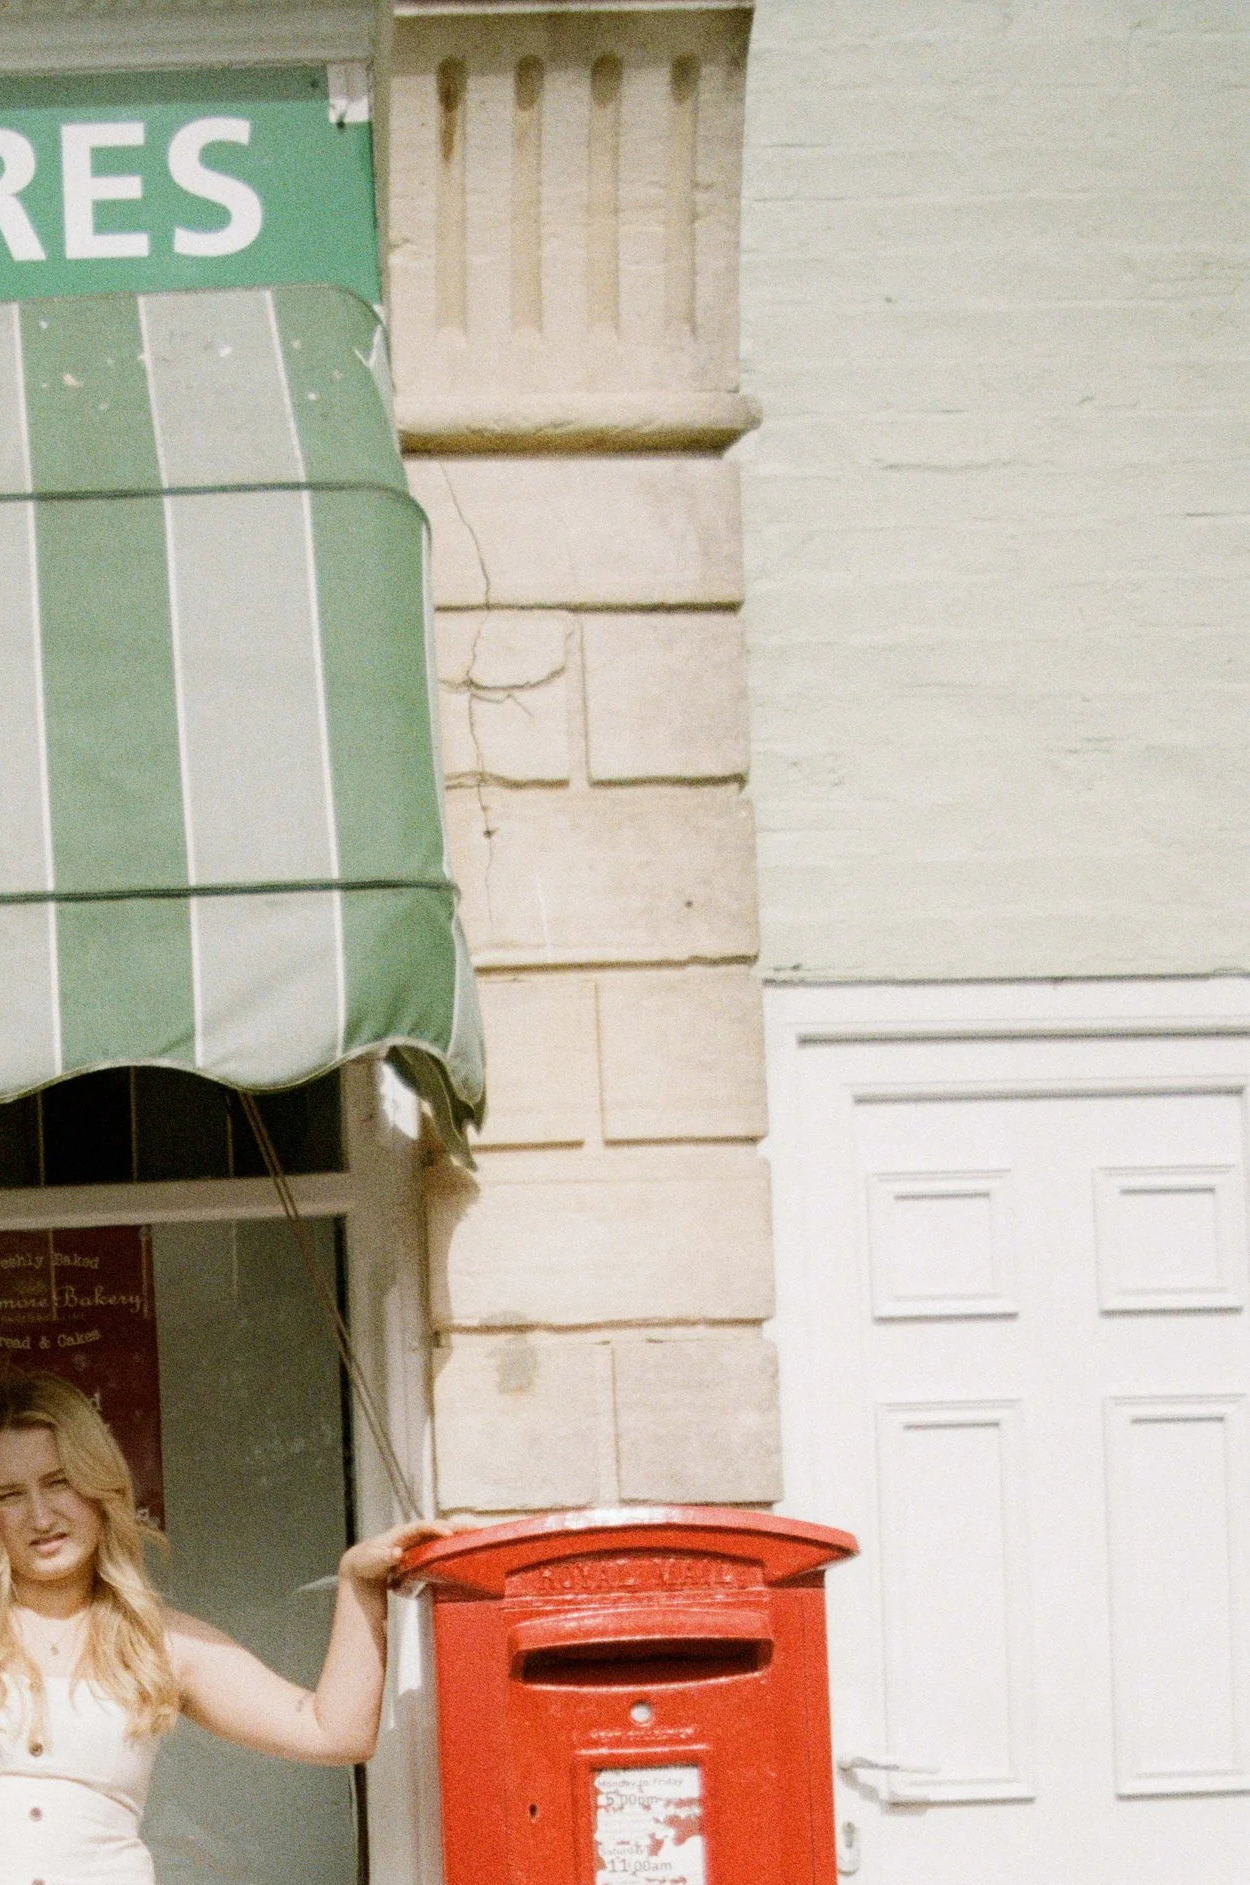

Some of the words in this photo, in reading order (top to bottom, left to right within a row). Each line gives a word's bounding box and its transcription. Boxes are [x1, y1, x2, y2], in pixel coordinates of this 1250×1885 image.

[51, 1253, 100, 1270] Baked
[54, 1285, 143, 1314] Bakery
[38, 1336, 51, 1350] &
[57, 1329, 102, 1348] Cakes
